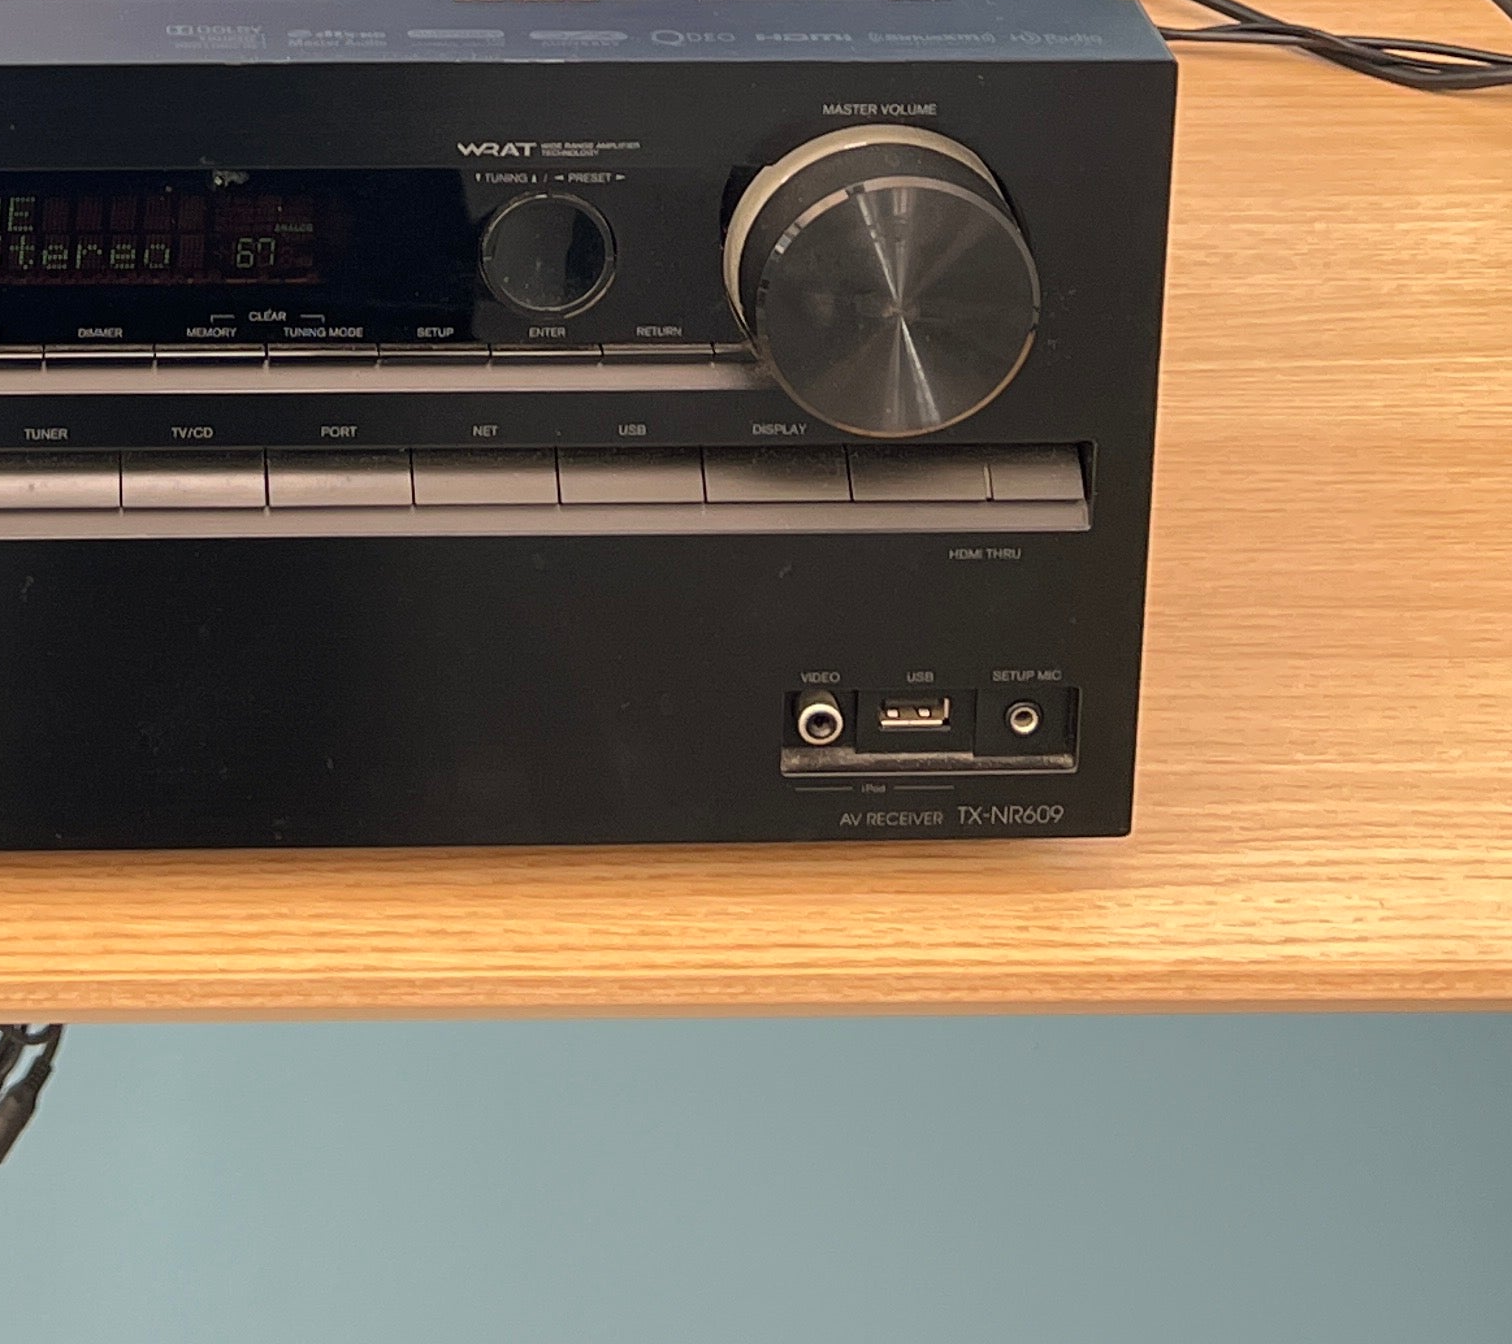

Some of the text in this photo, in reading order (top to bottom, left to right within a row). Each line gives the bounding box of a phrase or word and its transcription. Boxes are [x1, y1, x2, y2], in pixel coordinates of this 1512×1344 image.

[822, 103, 937, 116] MASTER VOLUME
[457, 142, 537, 157] WRAT
[484, 172, 529, 184] TUNING
[567, 172, 612, 184] PRESET
[234, 237, 276, 269] 67
[248, 310, 287, 322] CLEAR
[77, 327, 123, 339] DIMMER
[186, 326, 237, 338] MEMORY
[283, 326, 364, 338] TUNING MODE
[416, 326, 455, 338] SETUP
[528, 326, 566, 338] ENTER
[636, 325, 683, 337] RETURN
[23, 427, 68, 441] TUNER
[171, 426, 214, 439] TV/CD
[320, 425, 358, 438] PORT
[472, 424, 498, 437] NET
[618, 423, 647, 436] USB
[752, 423, 807, 436] DISPLAY
[948, 547, 1022, 560] HDMI THRU
[800, 671, 841, 684] VIDEO
[906, 671, 934, 684] USB
[992, 669, 1062, 682] SETUP MIC
[839, 804, 1065, 827] AV RECEIVER TX-NR609
